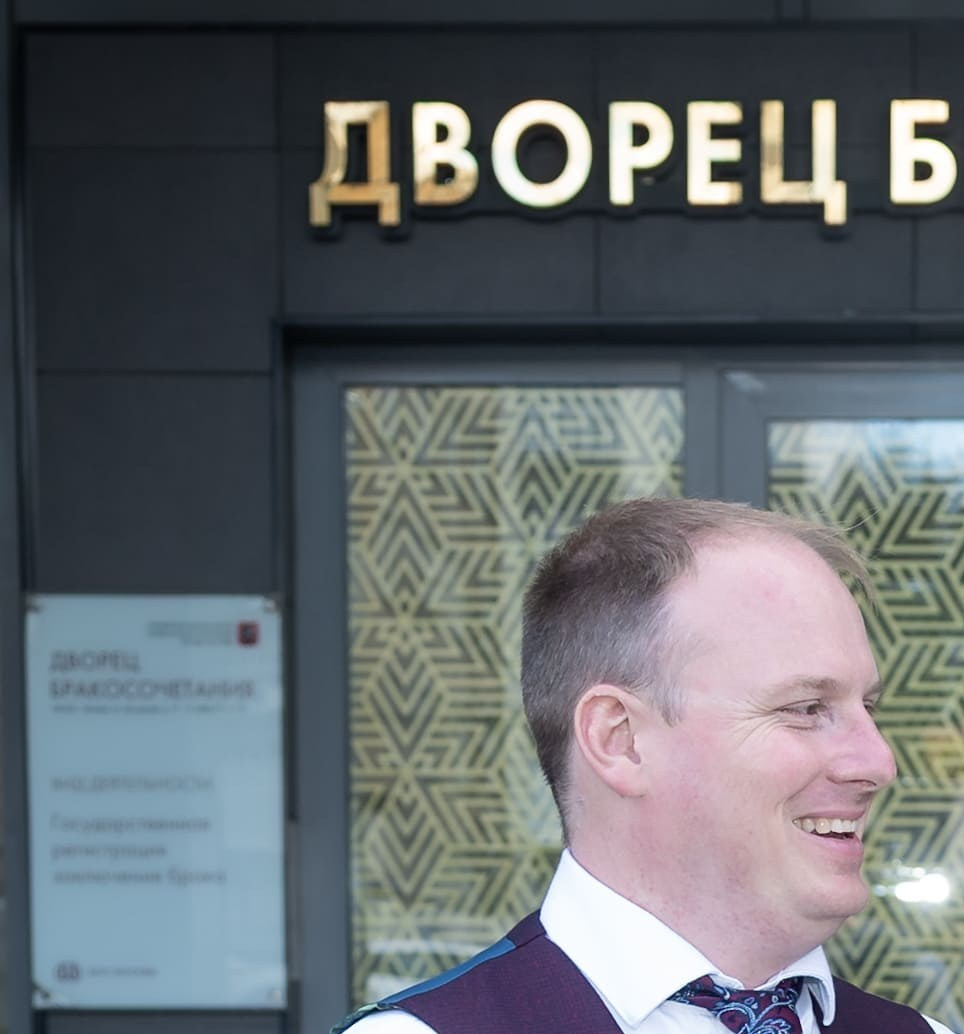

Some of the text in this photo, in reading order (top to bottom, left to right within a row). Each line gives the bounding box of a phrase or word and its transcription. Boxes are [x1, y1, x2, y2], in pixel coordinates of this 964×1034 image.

[309, 99, 847, 225] ДВОРЕЦ
[50, 651, 139, 672] ДВОРЕЦ
[50, 679, 254, 698] БРАКОСОЧЕТАНИЯ
